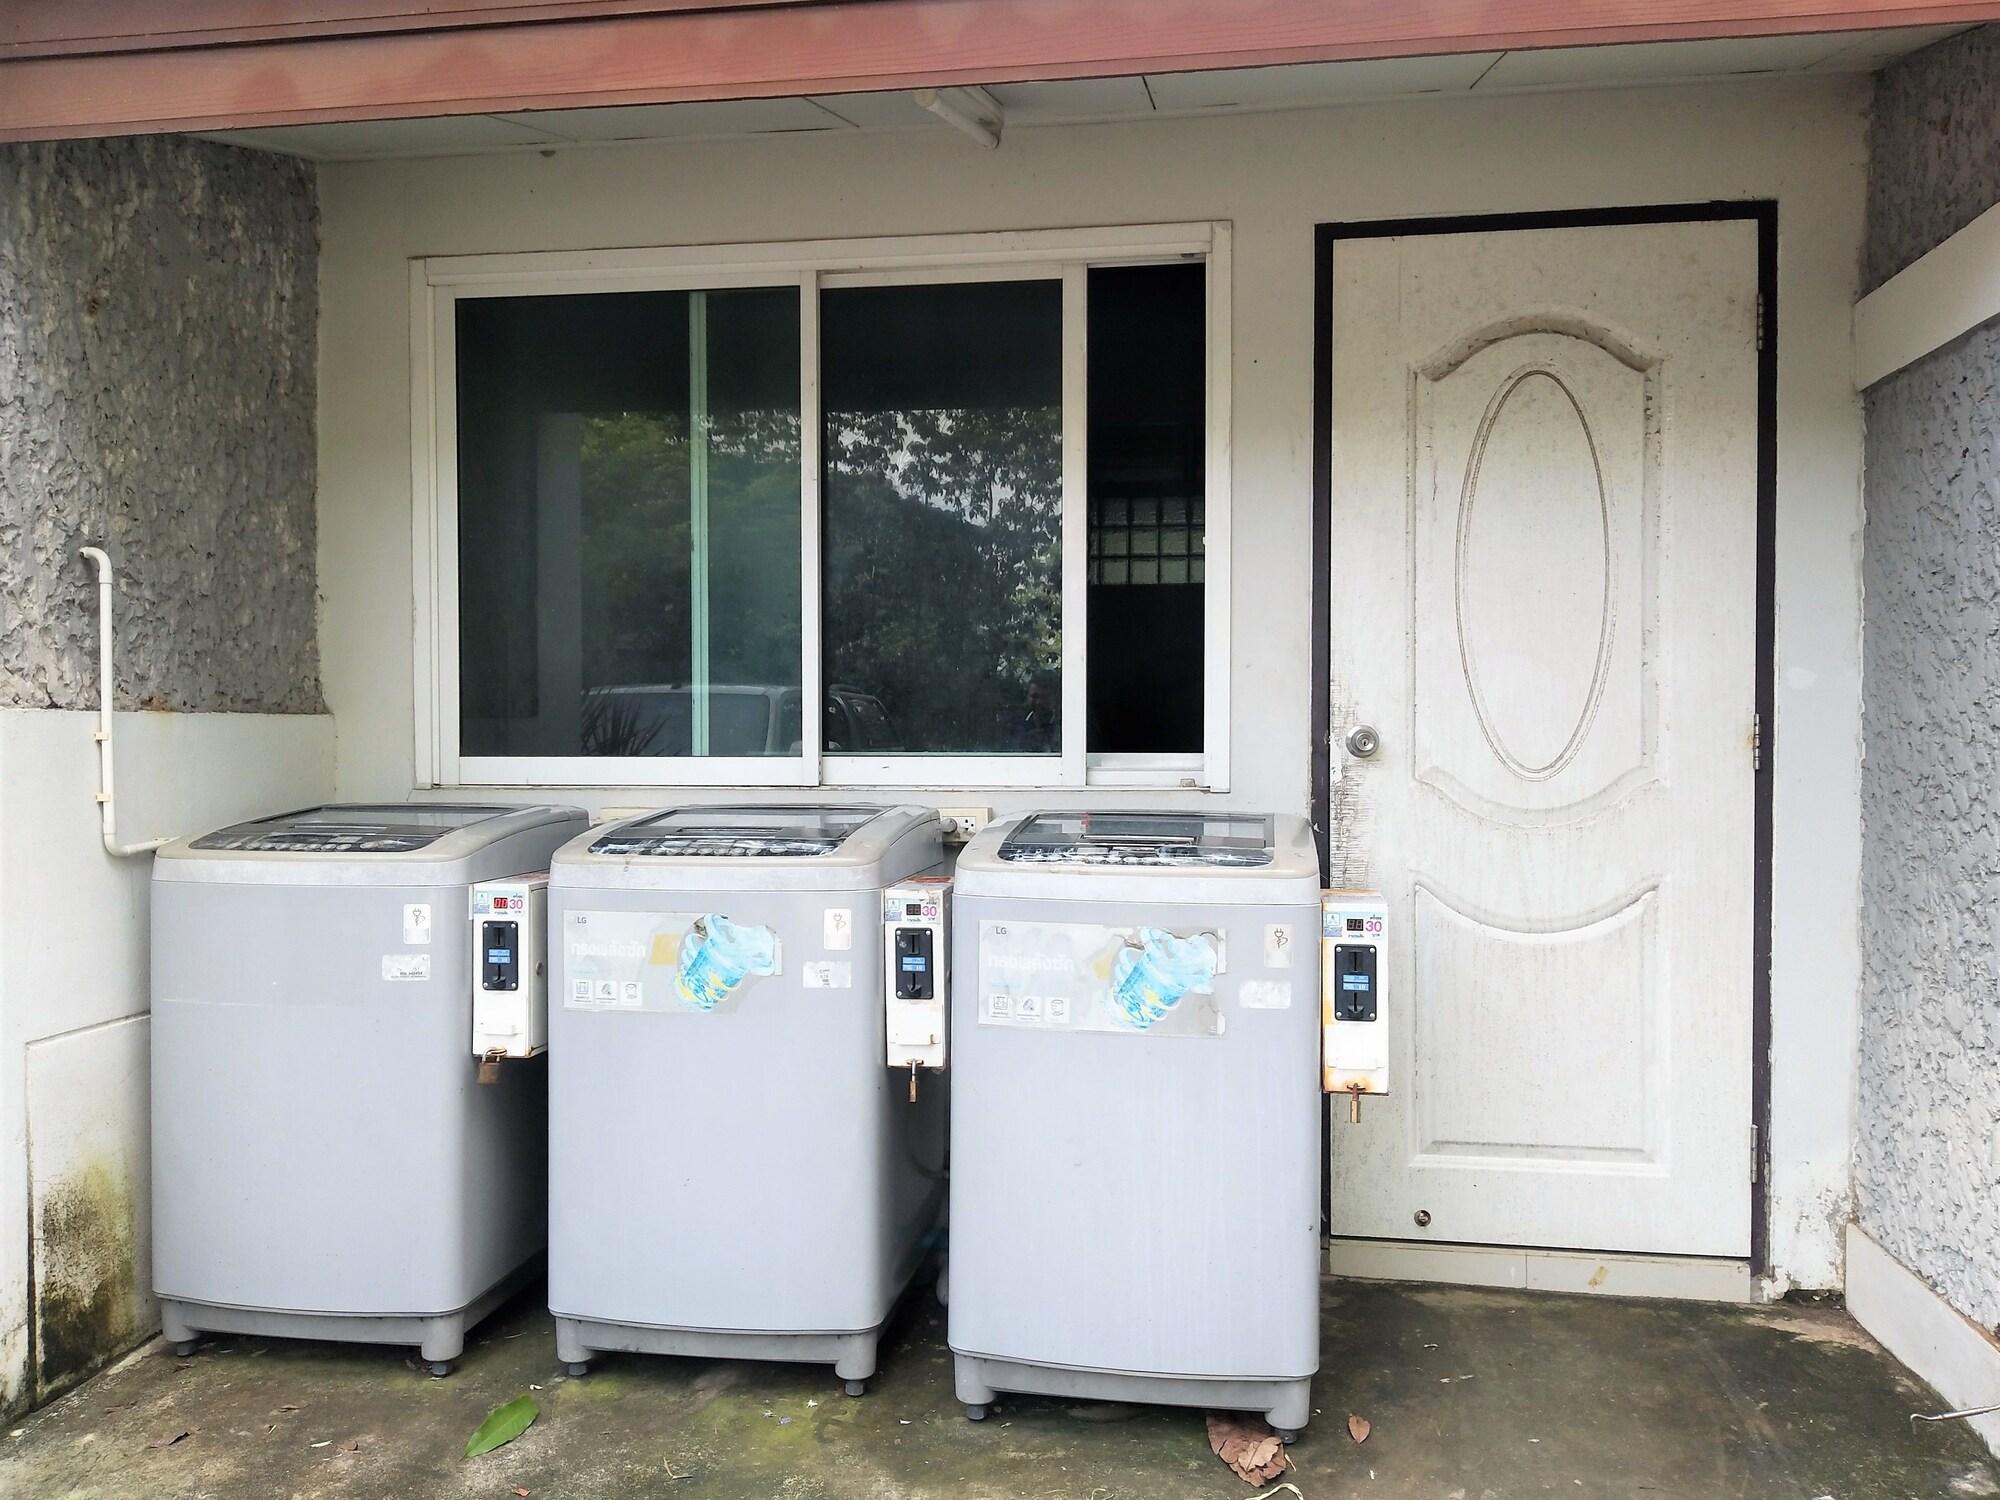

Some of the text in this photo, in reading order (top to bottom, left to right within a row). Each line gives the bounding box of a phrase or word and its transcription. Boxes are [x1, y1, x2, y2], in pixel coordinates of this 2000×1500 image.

[510, 899, 523, 909] 30
[922, 906, 937, 917] 30
[577, 916, 587, 924] LG
[995, 927, 1007, 935] LG
[1365, 921, 1382, 932] 30
